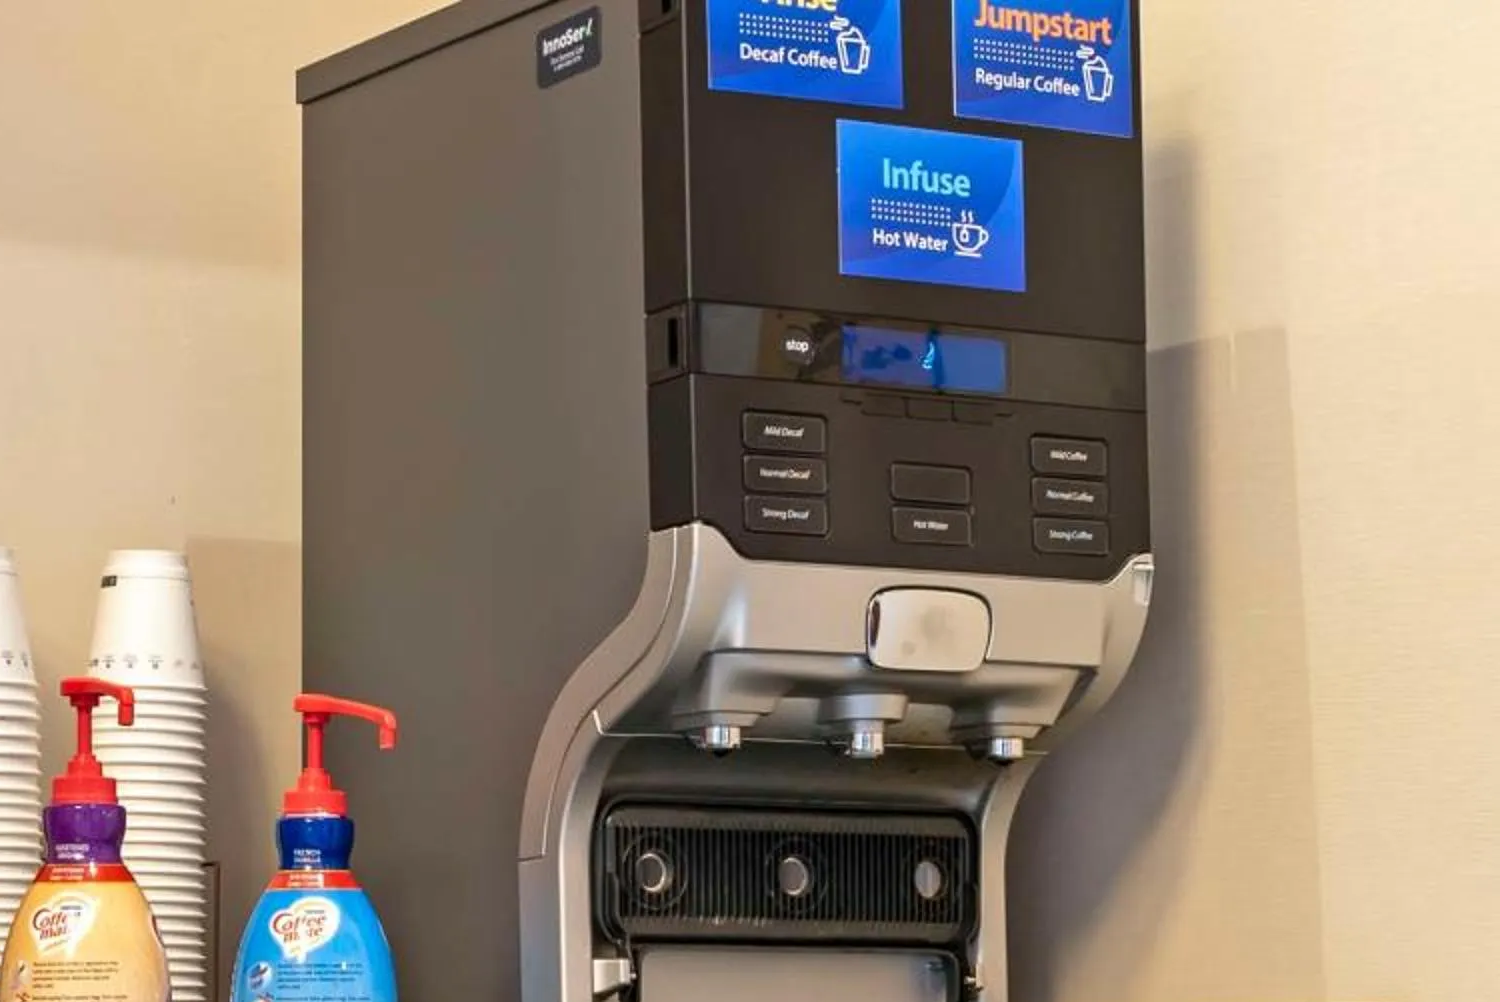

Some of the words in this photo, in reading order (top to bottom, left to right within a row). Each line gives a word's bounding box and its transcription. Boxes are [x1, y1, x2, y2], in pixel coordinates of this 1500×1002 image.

[974, 0, 1112, 45] Jumpstart
[739, 42, 786, 63] Decaf
[787, 49, 839, 70] Coffee
[975, 67, 1031, 91] Regular
[1033, 75, 1081, 97] Coffee
[883, 158, 971, 197] Infuse
[872, 228, 900, 246] Hot
[903, 231, 948, 252] Water
[785, 338, 809, 353] stop
